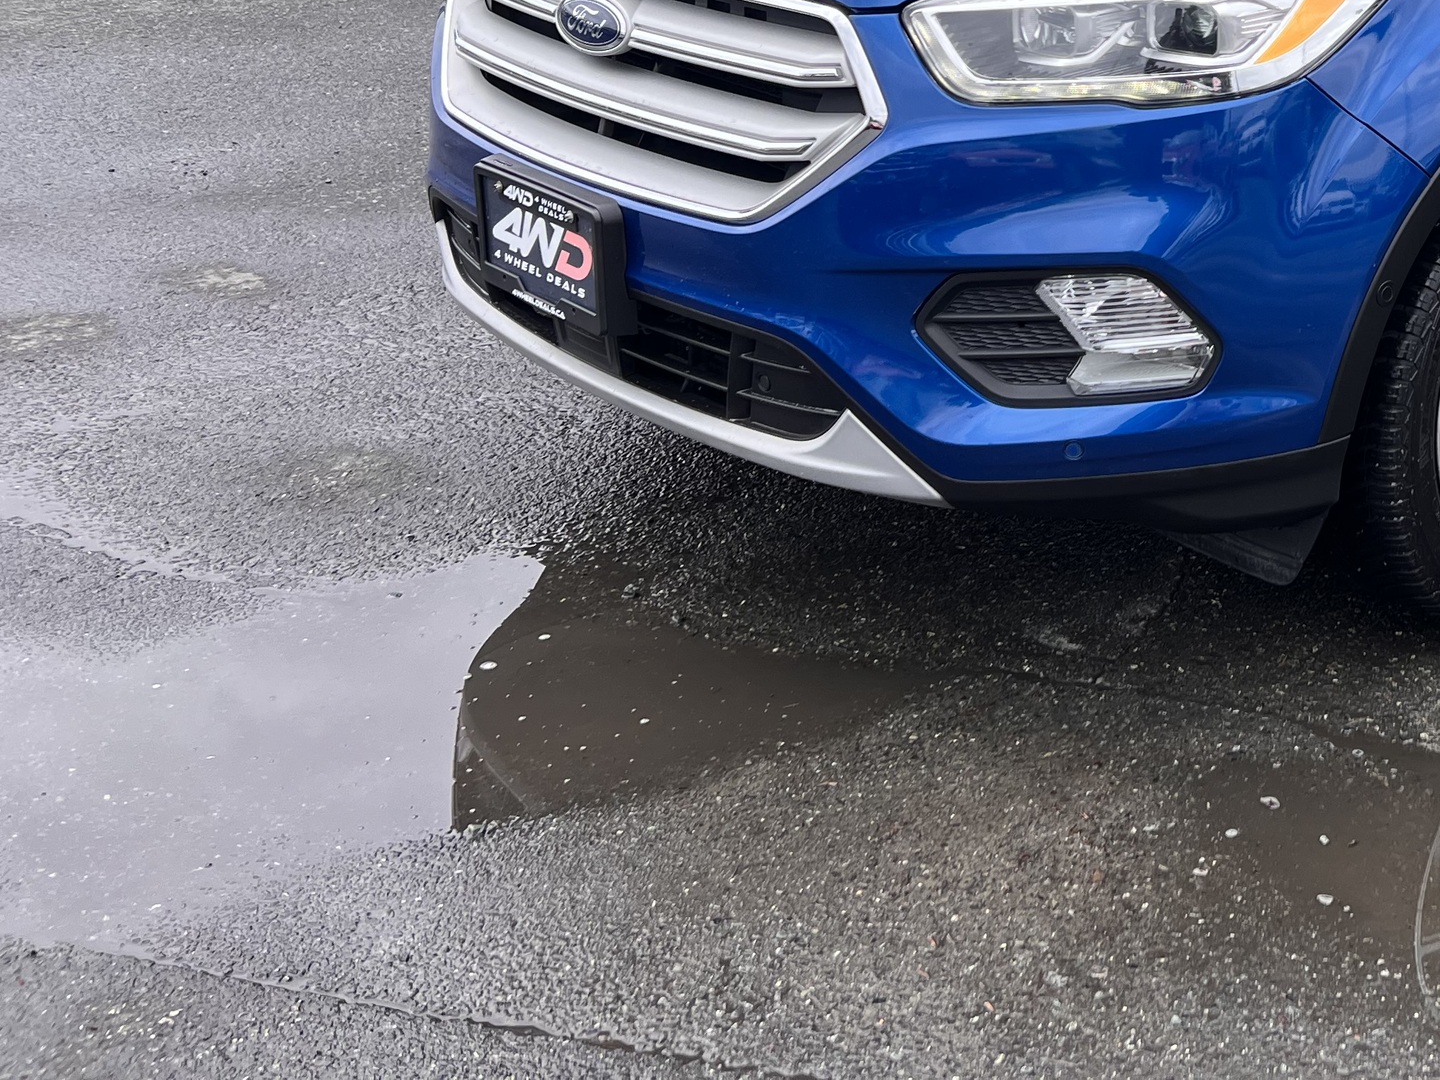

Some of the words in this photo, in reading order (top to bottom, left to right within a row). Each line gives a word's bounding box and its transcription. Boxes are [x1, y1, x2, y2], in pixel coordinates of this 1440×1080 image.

[567, 4, 607, 39] Ford
[533, 195, 540, 203] 4
[540, 197, 567, 214] WHEEL
[538, 205, 565, 222] DEALS
[492, 207, 593, 281] 4WD
[493, 249, 502, 259] 4
[504, 252, 542, 278] WHEEL
[546, 272, 586, 299] DEALS
